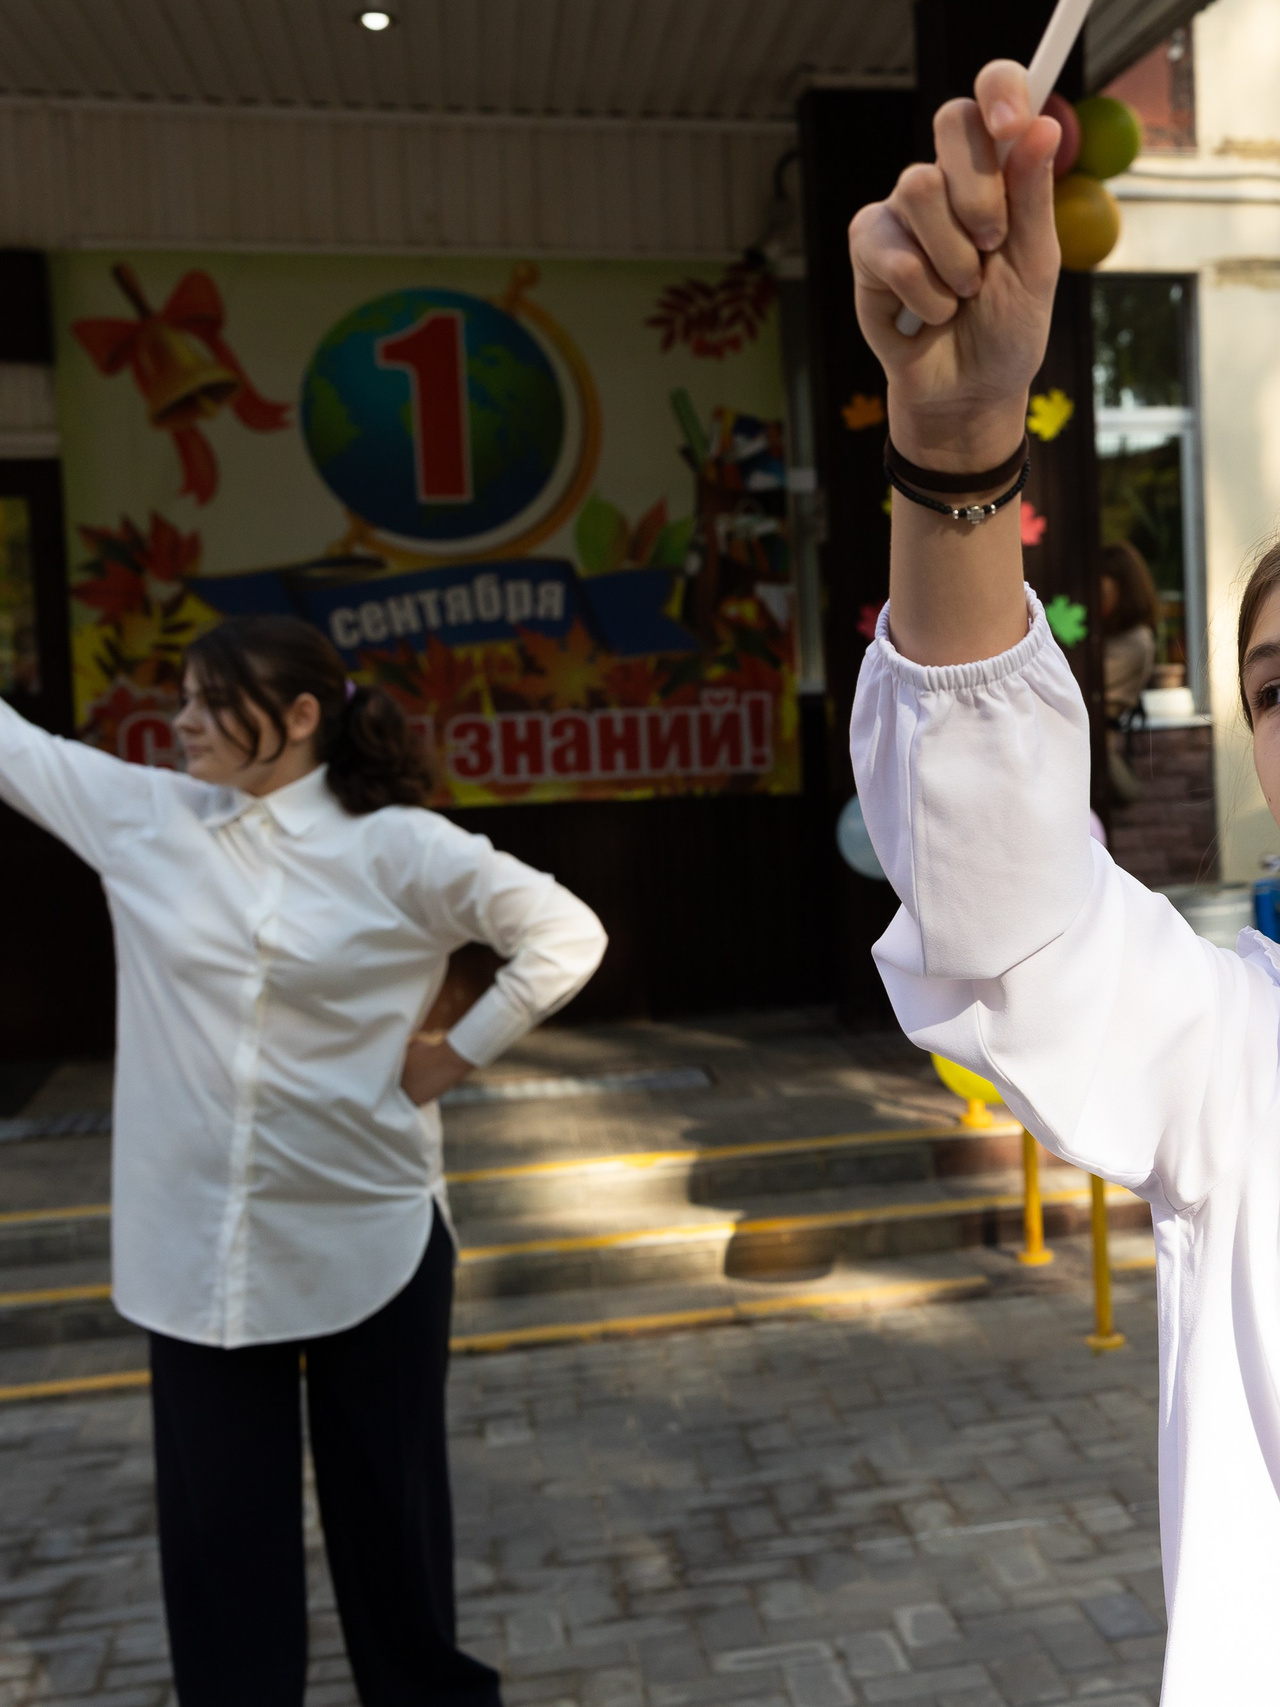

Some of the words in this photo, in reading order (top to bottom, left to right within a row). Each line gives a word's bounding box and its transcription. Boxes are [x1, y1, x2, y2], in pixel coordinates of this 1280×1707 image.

[376, 309, 472, 503] 1
[327, 571, 567, 650] сентября
[448, 692, 770, 780] знаний!
